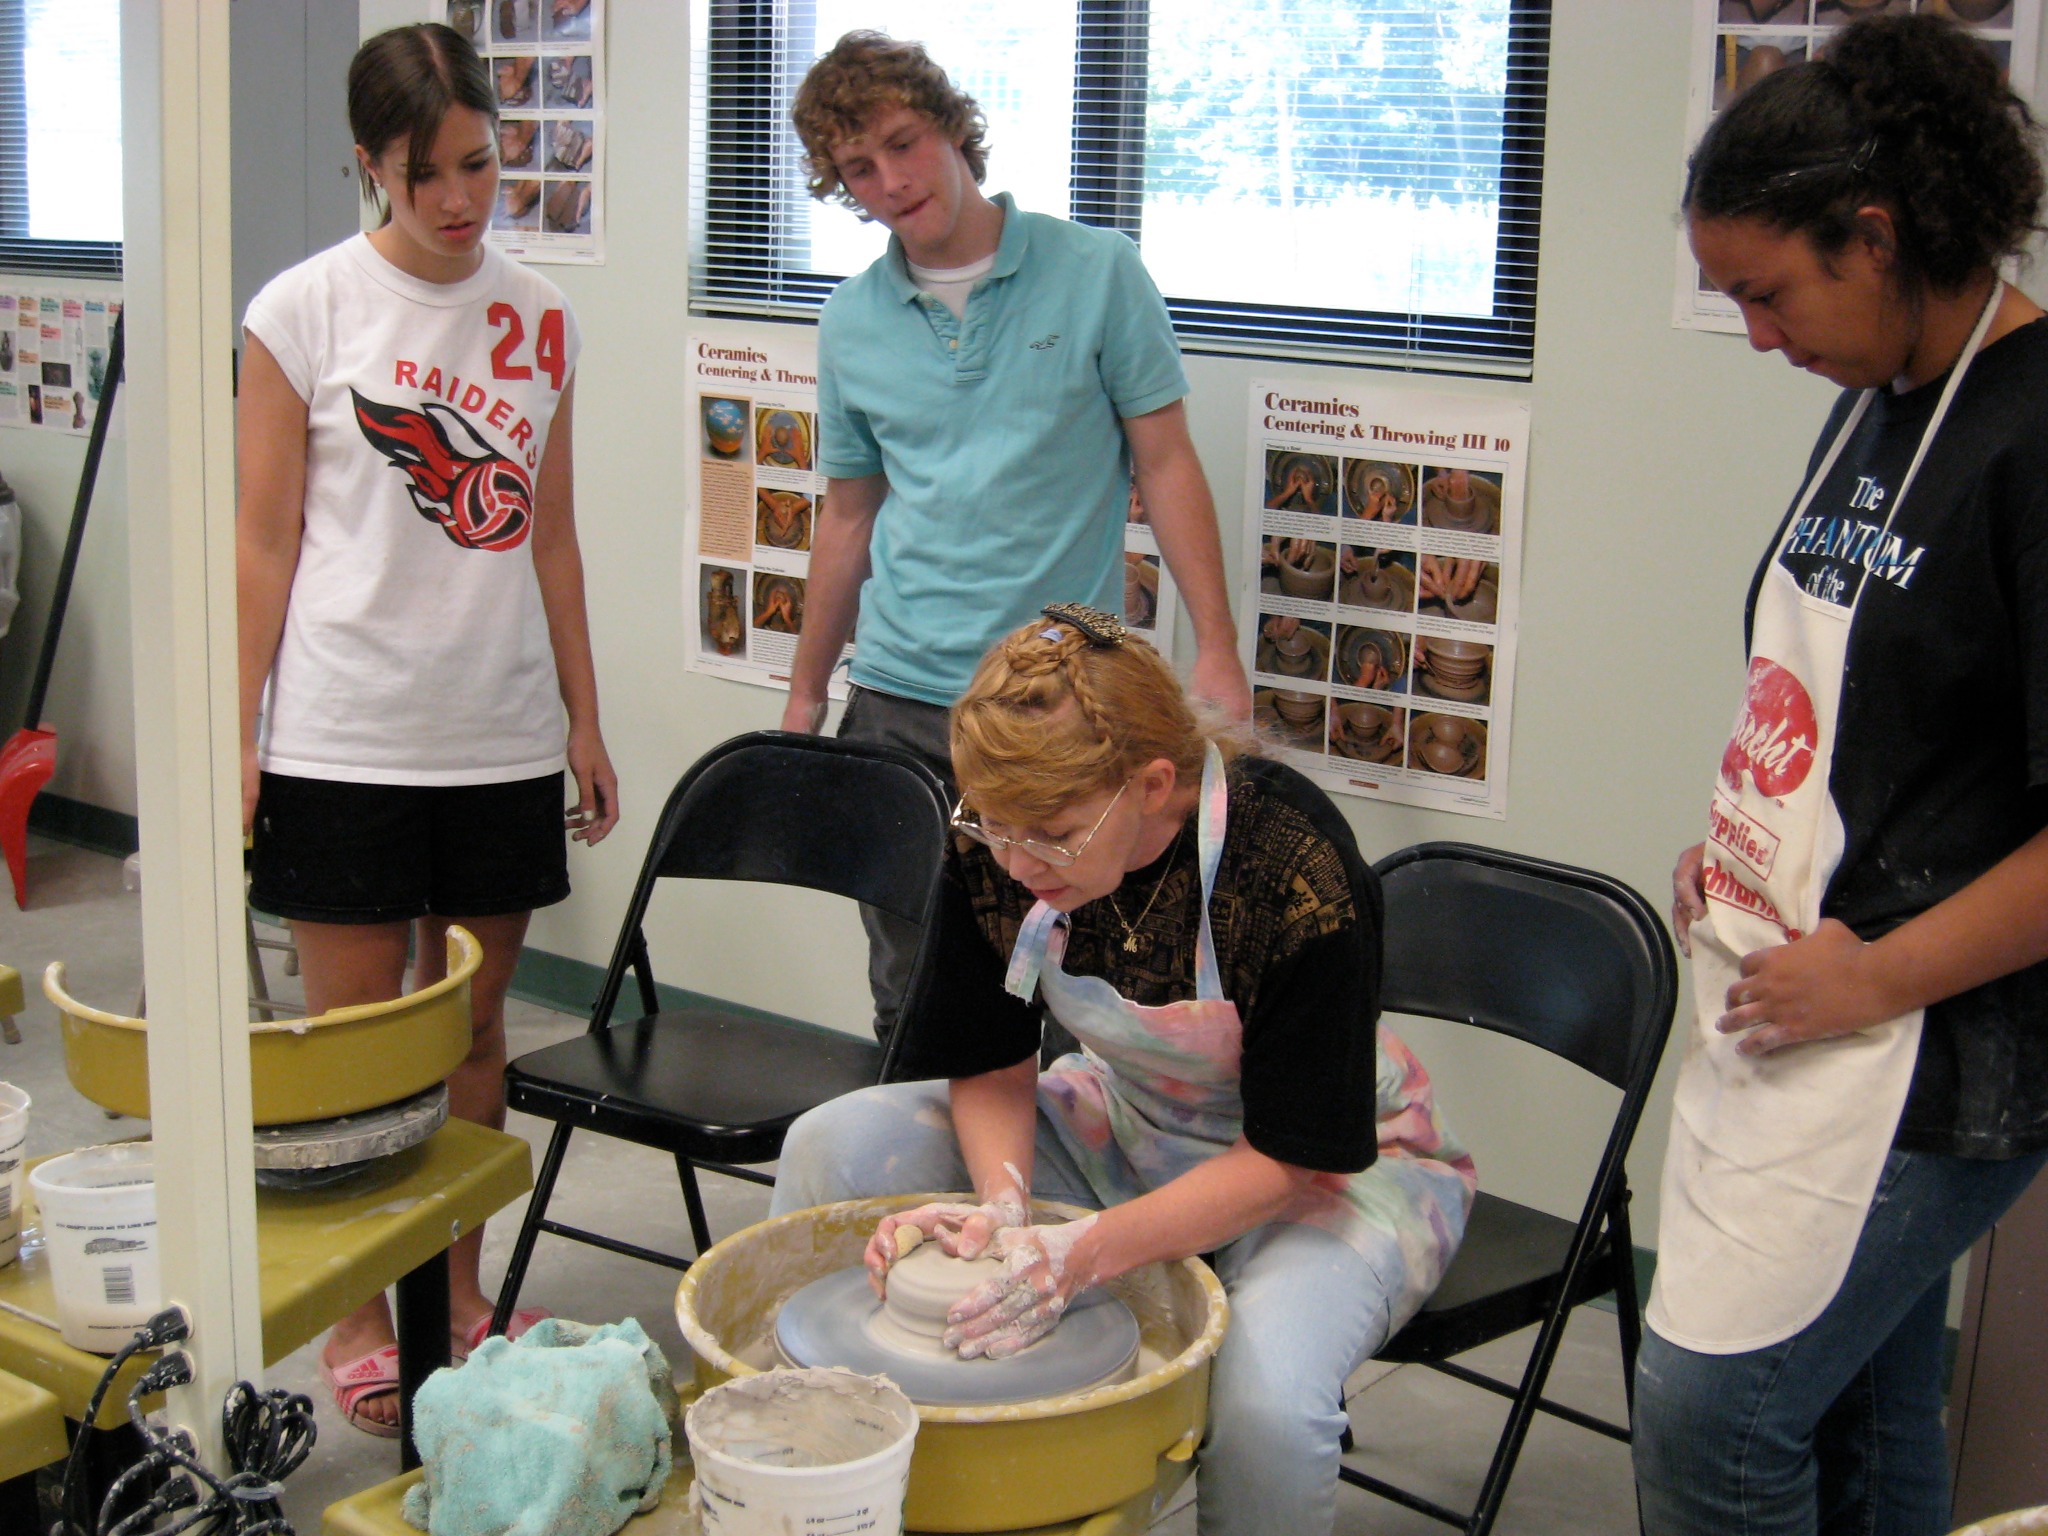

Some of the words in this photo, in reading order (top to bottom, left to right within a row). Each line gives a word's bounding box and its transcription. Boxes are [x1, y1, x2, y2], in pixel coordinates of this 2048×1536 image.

[487, 302, 566, 392] 24
[698, 342, 768, 364] Ceramics
[697, 362, 758, 383] Centering
[760, 368, 772, 382] &
[1264, 391, 1360, 418] Ceramics
[1263, 414, 1347, 440] Centering
[1350, 423, 1365, 439] &
[1369, 424, 1458, 451] Throwing
[1462, 432, 1488, 450] III
[1493, 437, 1511, 453] 10
[1849, 476, 1886, 511] The
[1805, 564, 1829, 598] of
[1821, 568, 1846, 603] the
[1708, 799, 1770, 866] Supplies
